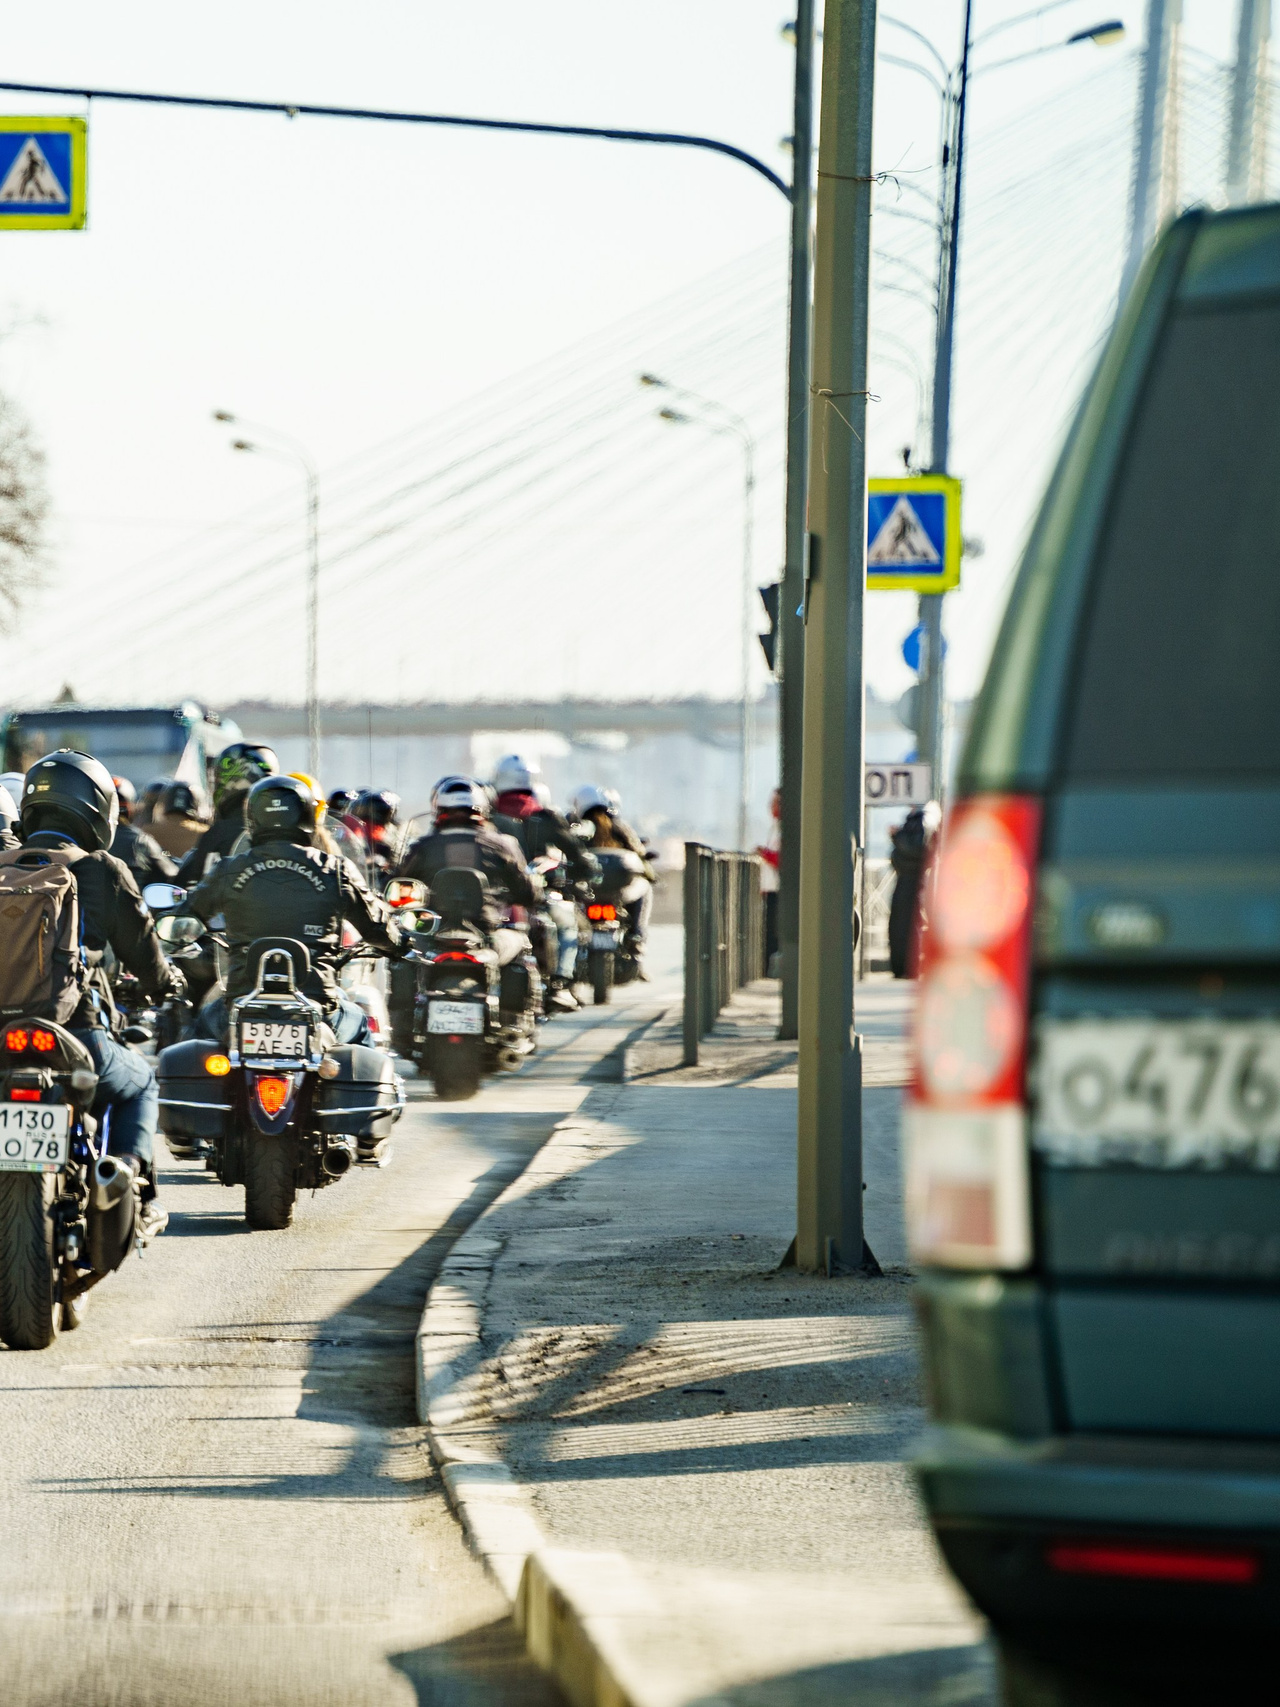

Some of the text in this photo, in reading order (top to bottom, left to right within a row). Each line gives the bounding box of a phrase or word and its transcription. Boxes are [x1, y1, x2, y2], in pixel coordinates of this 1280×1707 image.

[232, 859, 326, 892] THE HOOLIGANS
[250, 1022, 300, 1039] 5876
[32, 1140, 59, 1159] 78
